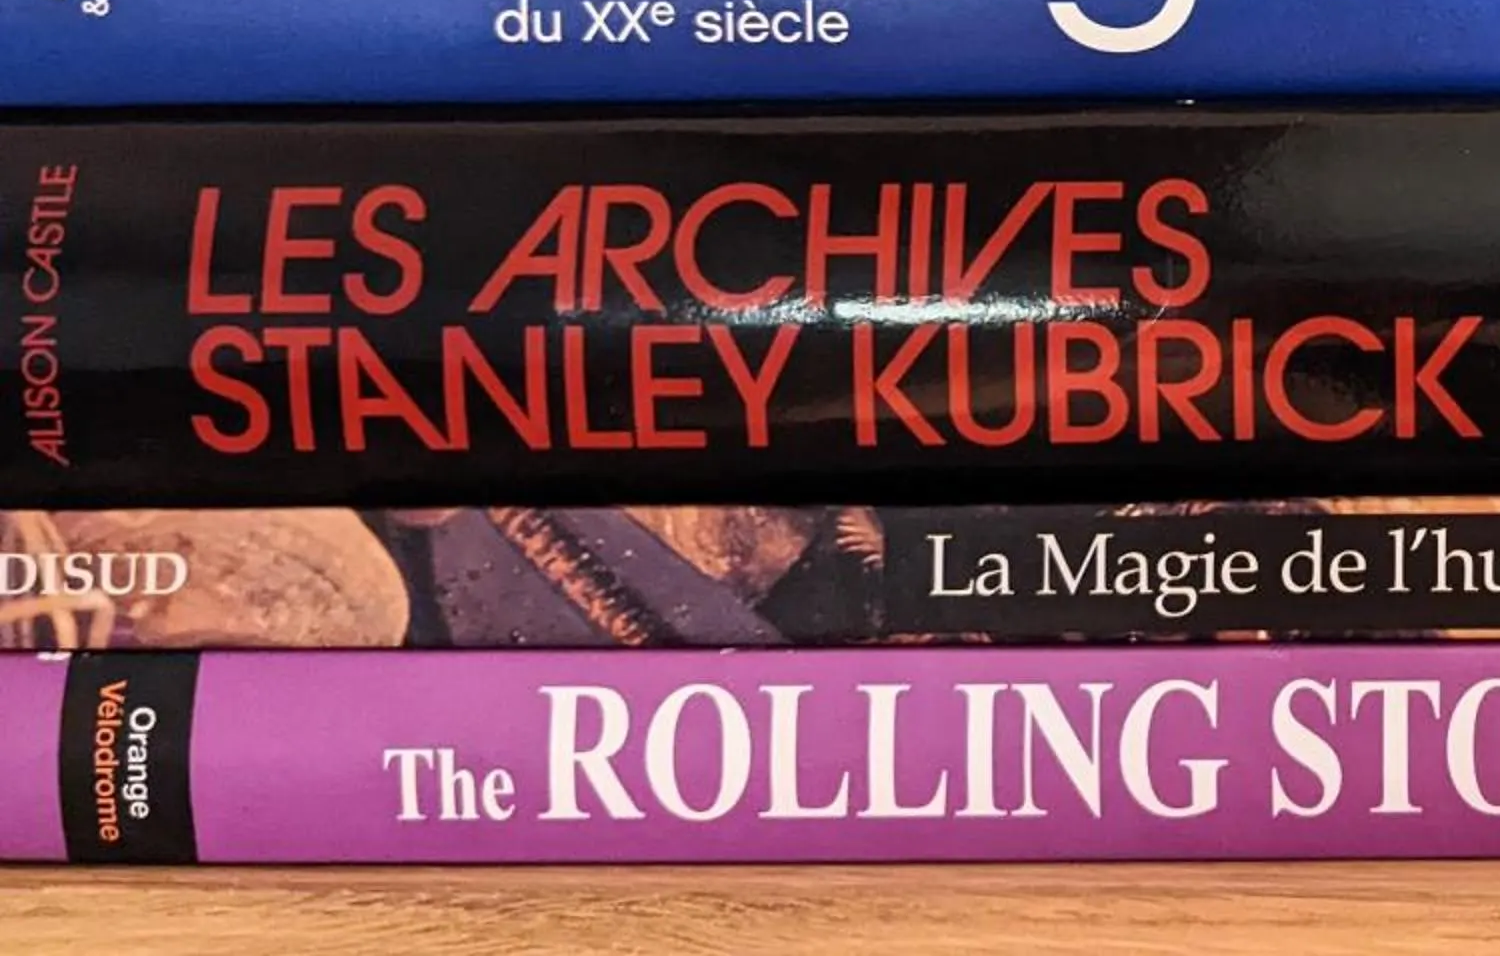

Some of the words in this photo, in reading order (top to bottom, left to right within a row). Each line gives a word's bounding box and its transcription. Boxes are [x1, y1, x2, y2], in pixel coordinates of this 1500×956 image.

[22, 163, 78, 302] CASTLE
[188, 184, 427, 315] LES
[468, 178, 1211, 312] ARCHIVES
[21, 315, 70, 467] ALISON
[190, 325, 802, 453] STANLEY
[853, 316, 1483, 446] KUBRICK
[927, 532, 1014, 596] La
[1035, 532, 1258, 617] Magie
[1280, 532, 1368, 595] de
[93, 679, 128, 842] Vélodrome
[122, 707, 157, 820] Orange
[384, 748, 515, 821] The
[537, 679, 1229, 821] ROLLING
